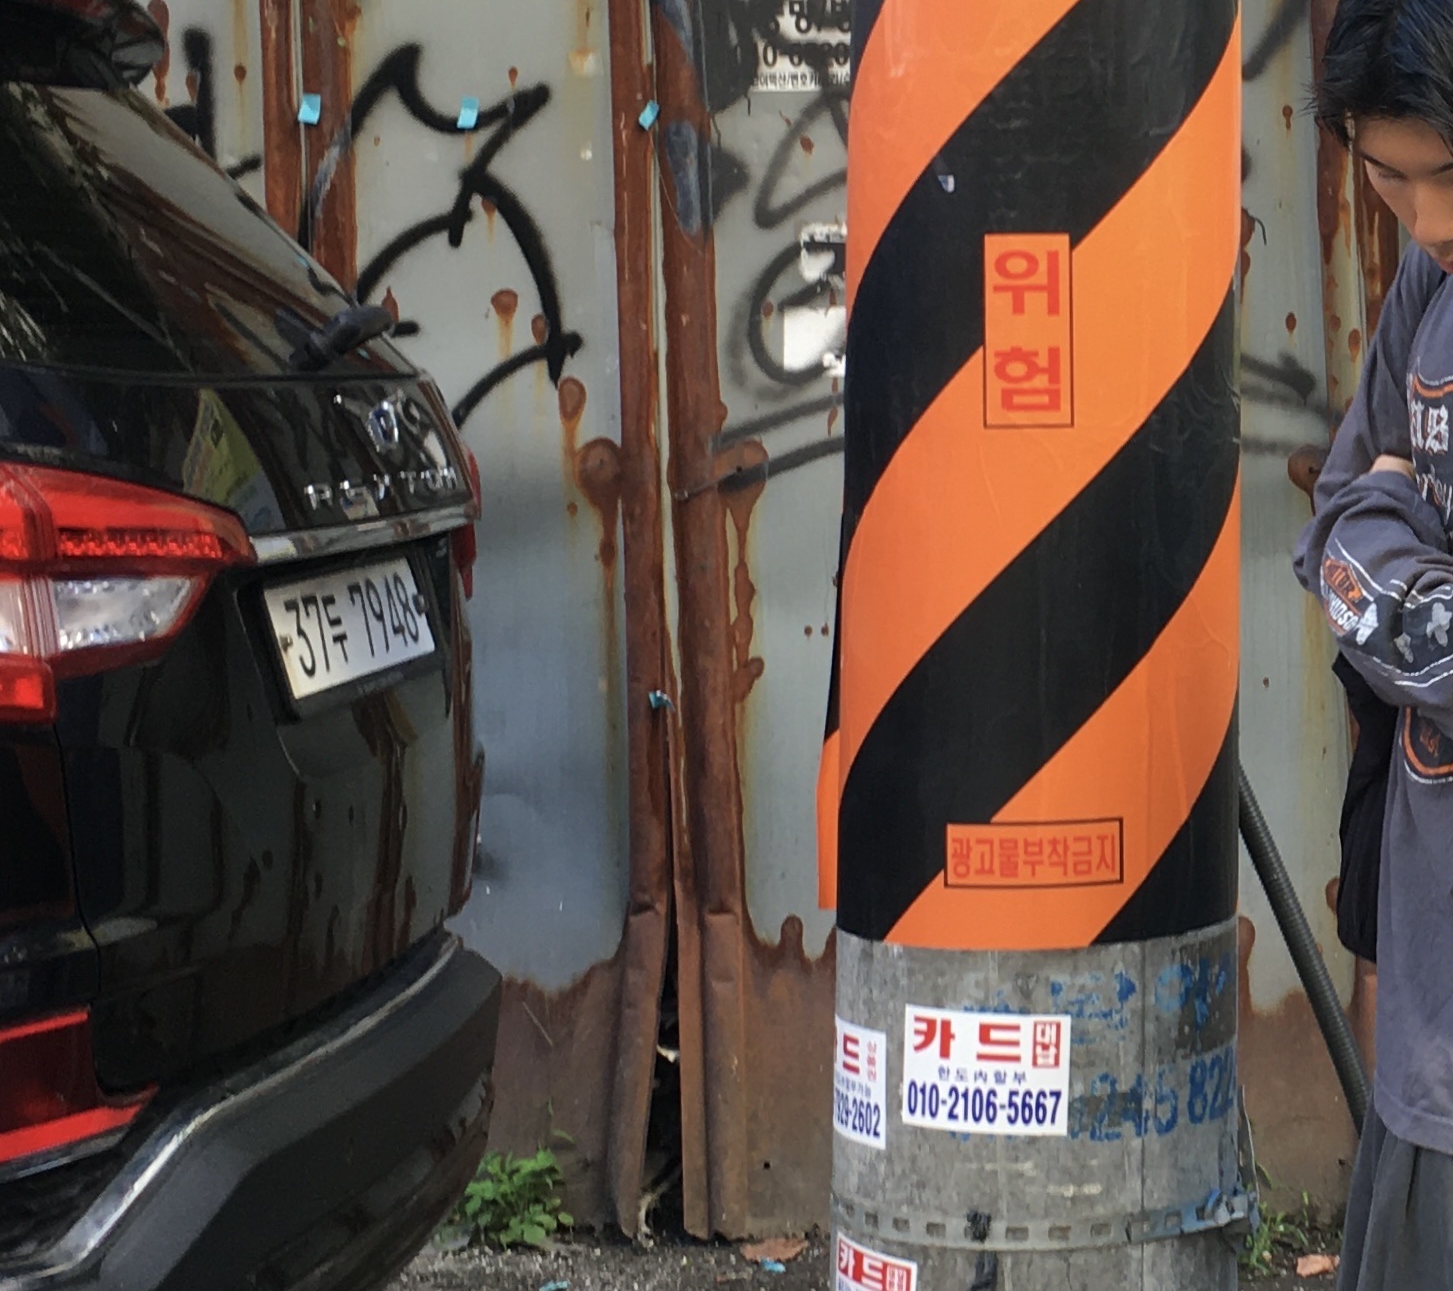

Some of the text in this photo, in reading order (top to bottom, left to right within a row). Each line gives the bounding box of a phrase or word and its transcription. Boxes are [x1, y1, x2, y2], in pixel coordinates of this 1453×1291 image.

[993, 249, 1062, 414] 위험
[347, 571, 421, 658] 7948
[950, 833, 1118, 882] 광고물부착금지
[835, 1033, 860, 1076] 드
[907, 1079, 1062, 1127] 010-2106-5667
[838, 1240, 884, 1291] 카드
